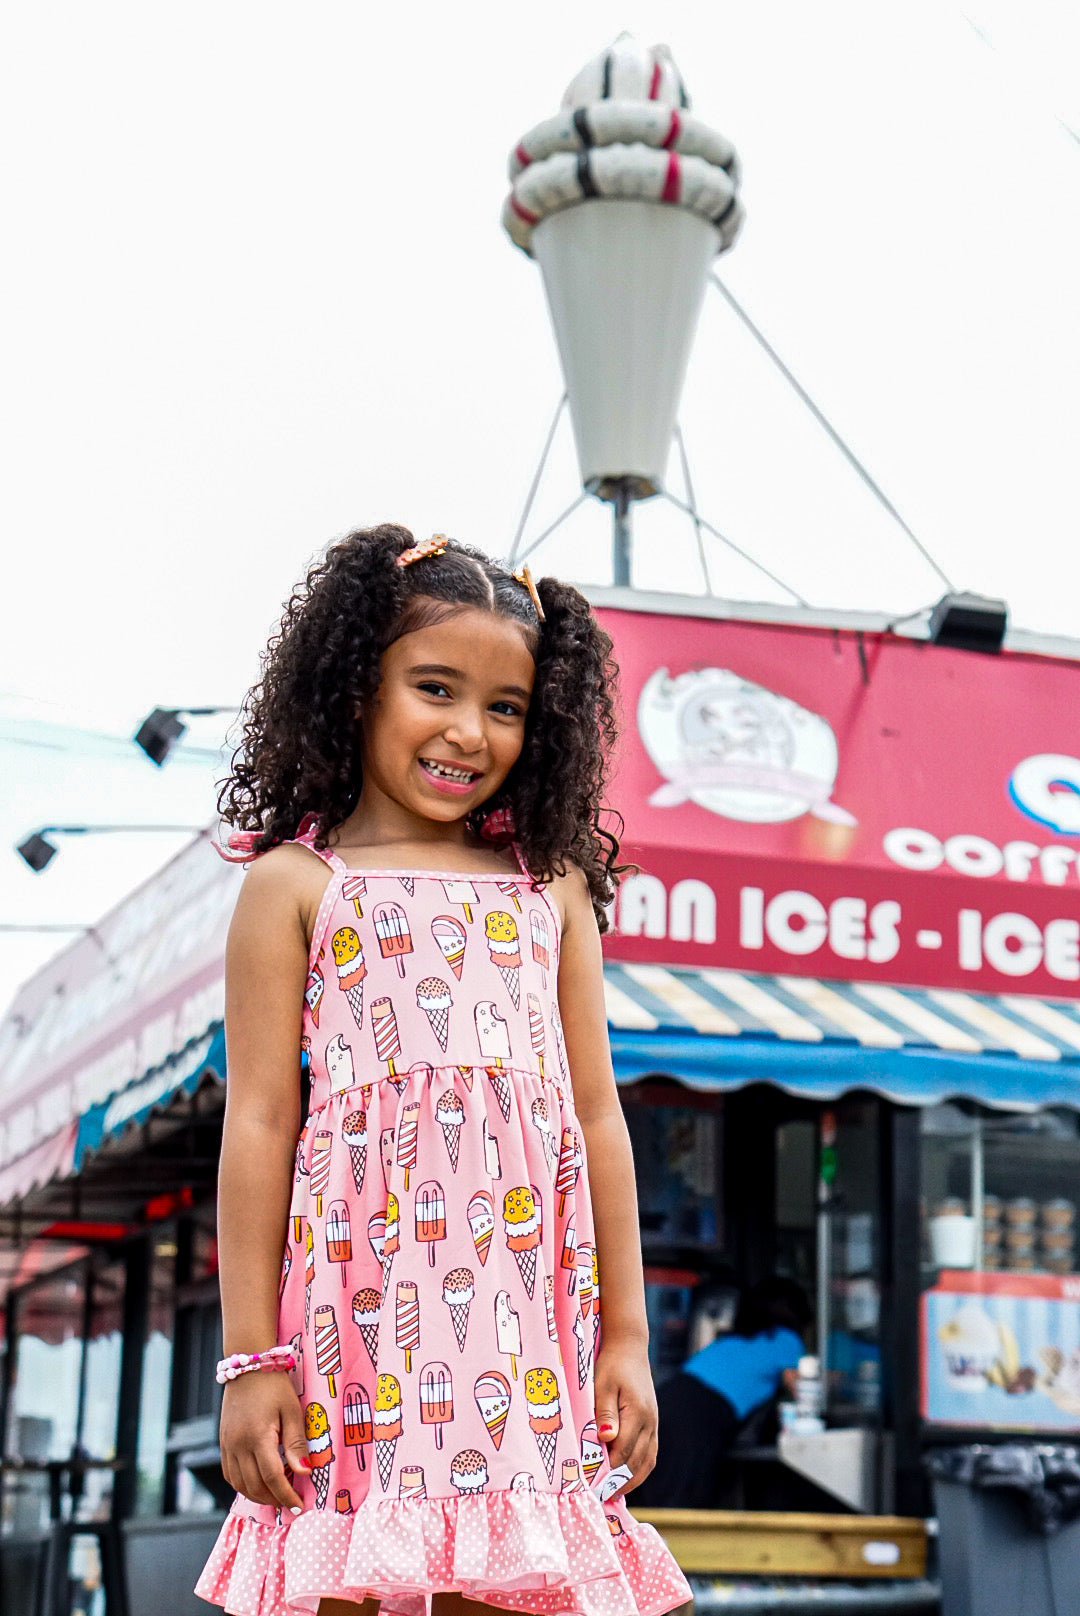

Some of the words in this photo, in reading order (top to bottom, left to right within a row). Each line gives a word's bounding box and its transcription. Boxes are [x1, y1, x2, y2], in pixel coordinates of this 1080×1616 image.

[882, 827, 1080, 886] COFF
[740, 886, 901, 963] ICES
[917, 930, 942, 949] -
[958, 909, 1080, 981] ICE
